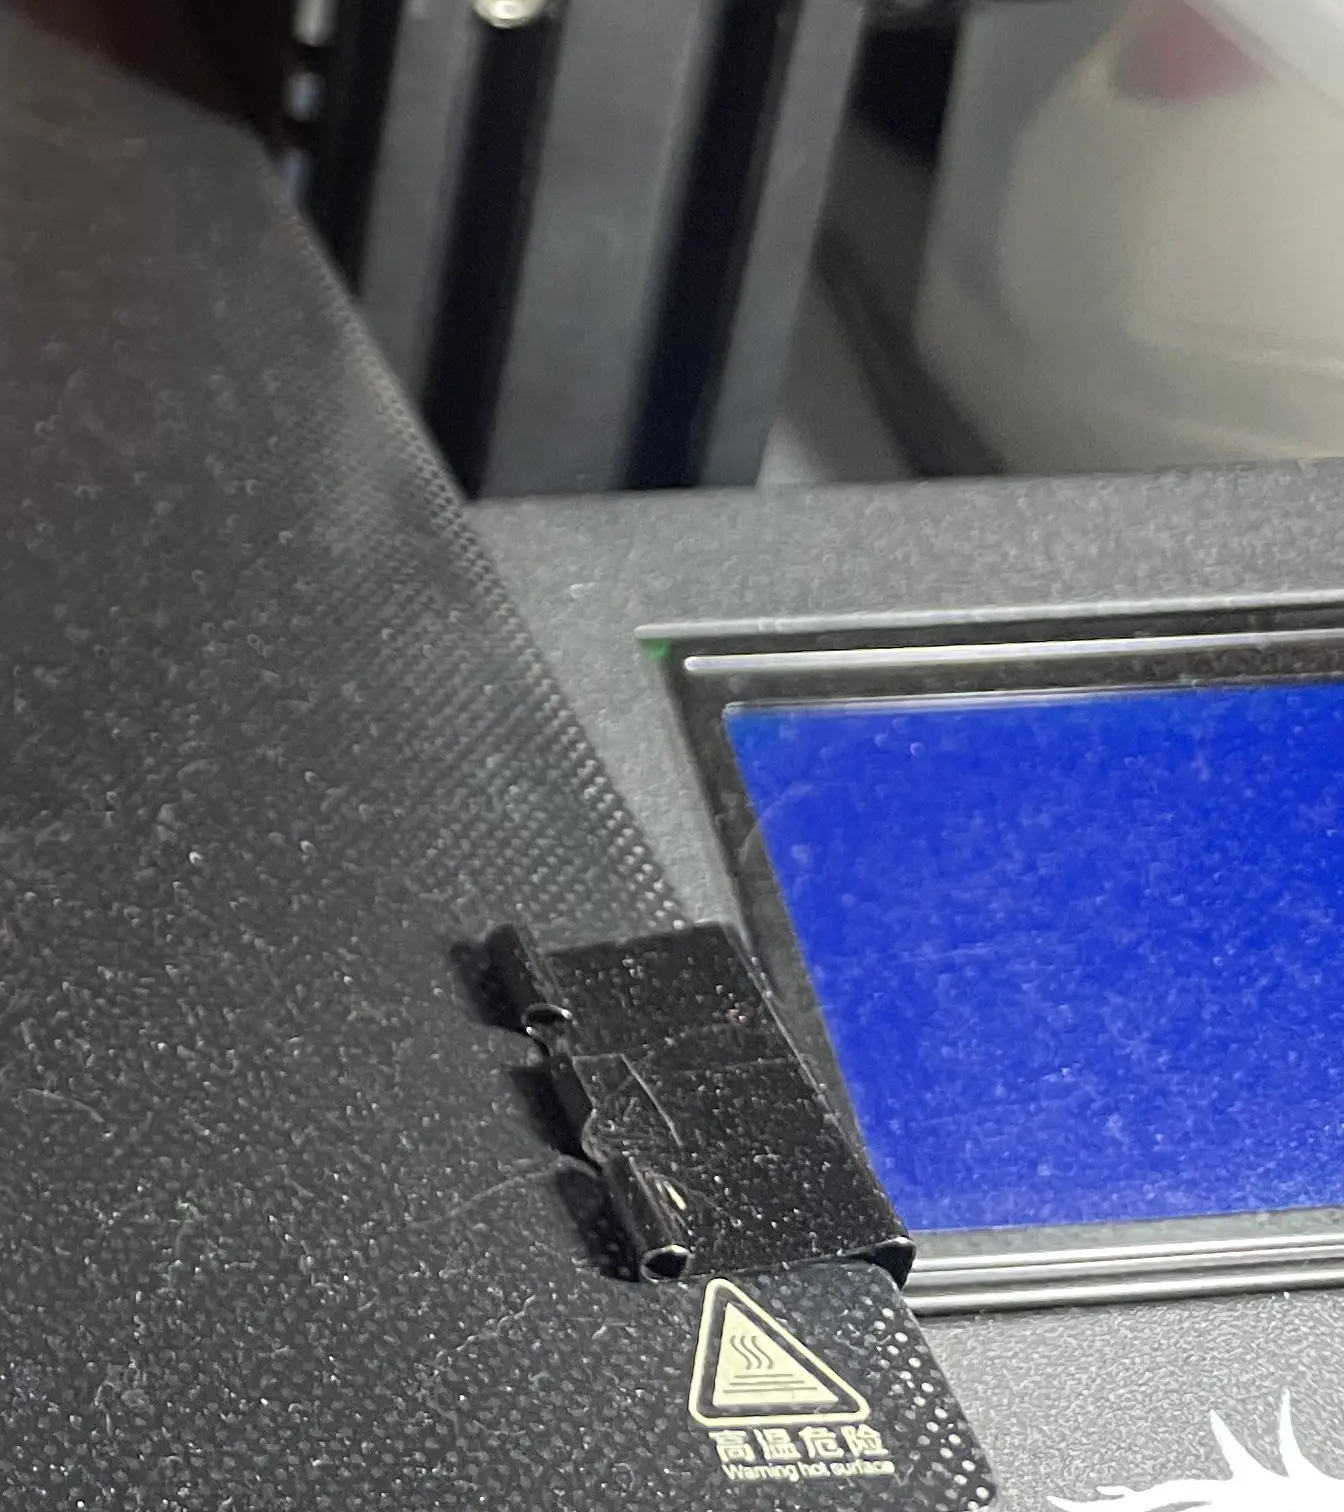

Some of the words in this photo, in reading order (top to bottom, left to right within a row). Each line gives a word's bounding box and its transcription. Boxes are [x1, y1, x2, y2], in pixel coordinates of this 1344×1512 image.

[708, 1424, 889, 1463] 高温危险
[722, 1463, 799, 1482] Warning
[798, 1461, 830, 1476] hot
[830, 1459, 895, 1475] surface
